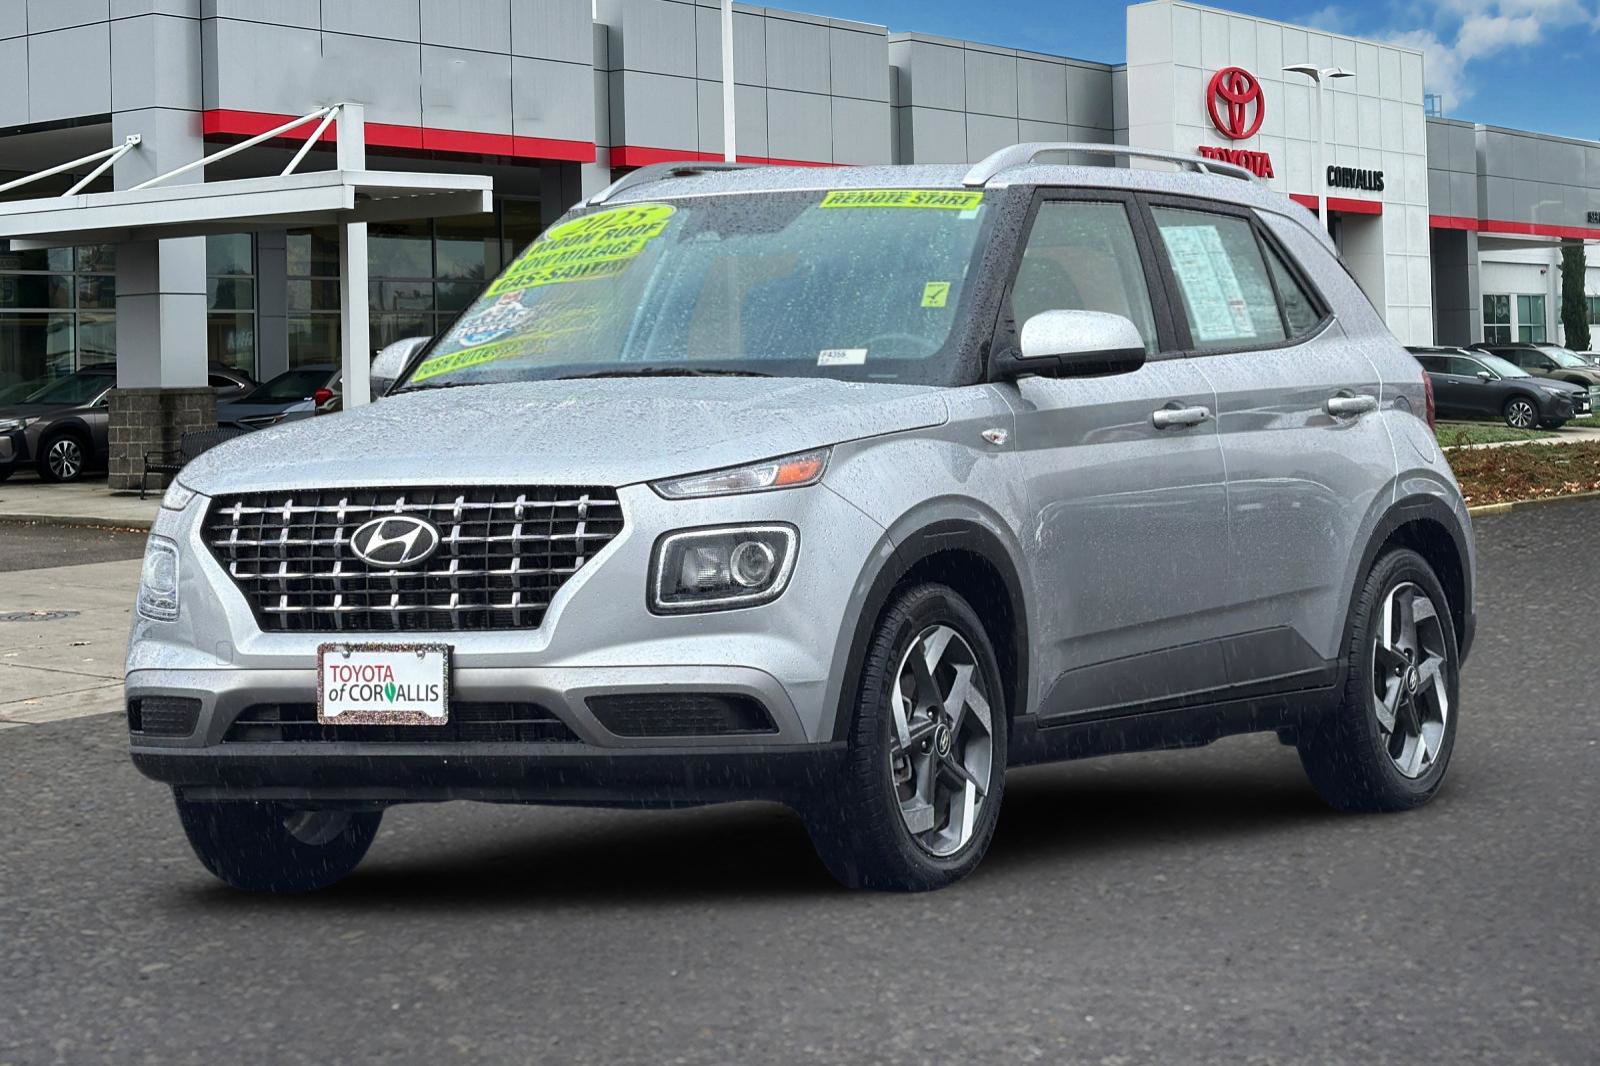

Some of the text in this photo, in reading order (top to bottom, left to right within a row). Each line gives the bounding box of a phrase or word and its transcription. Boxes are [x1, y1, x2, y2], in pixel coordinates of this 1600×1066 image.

[1198, 146, 1274, 178] TOYOTA
[1326, 165, 1384, 191] CORVALLIS
[827, 191, 976, 205] REMOTE START
[535, 221, 662, 254] MOON ROOF
[513, 239, 642, 273] LOW MILEAGE
[330, 665, 395, 682] TOYOTA
[328, 682, 439, 703] of CORVALLIS
